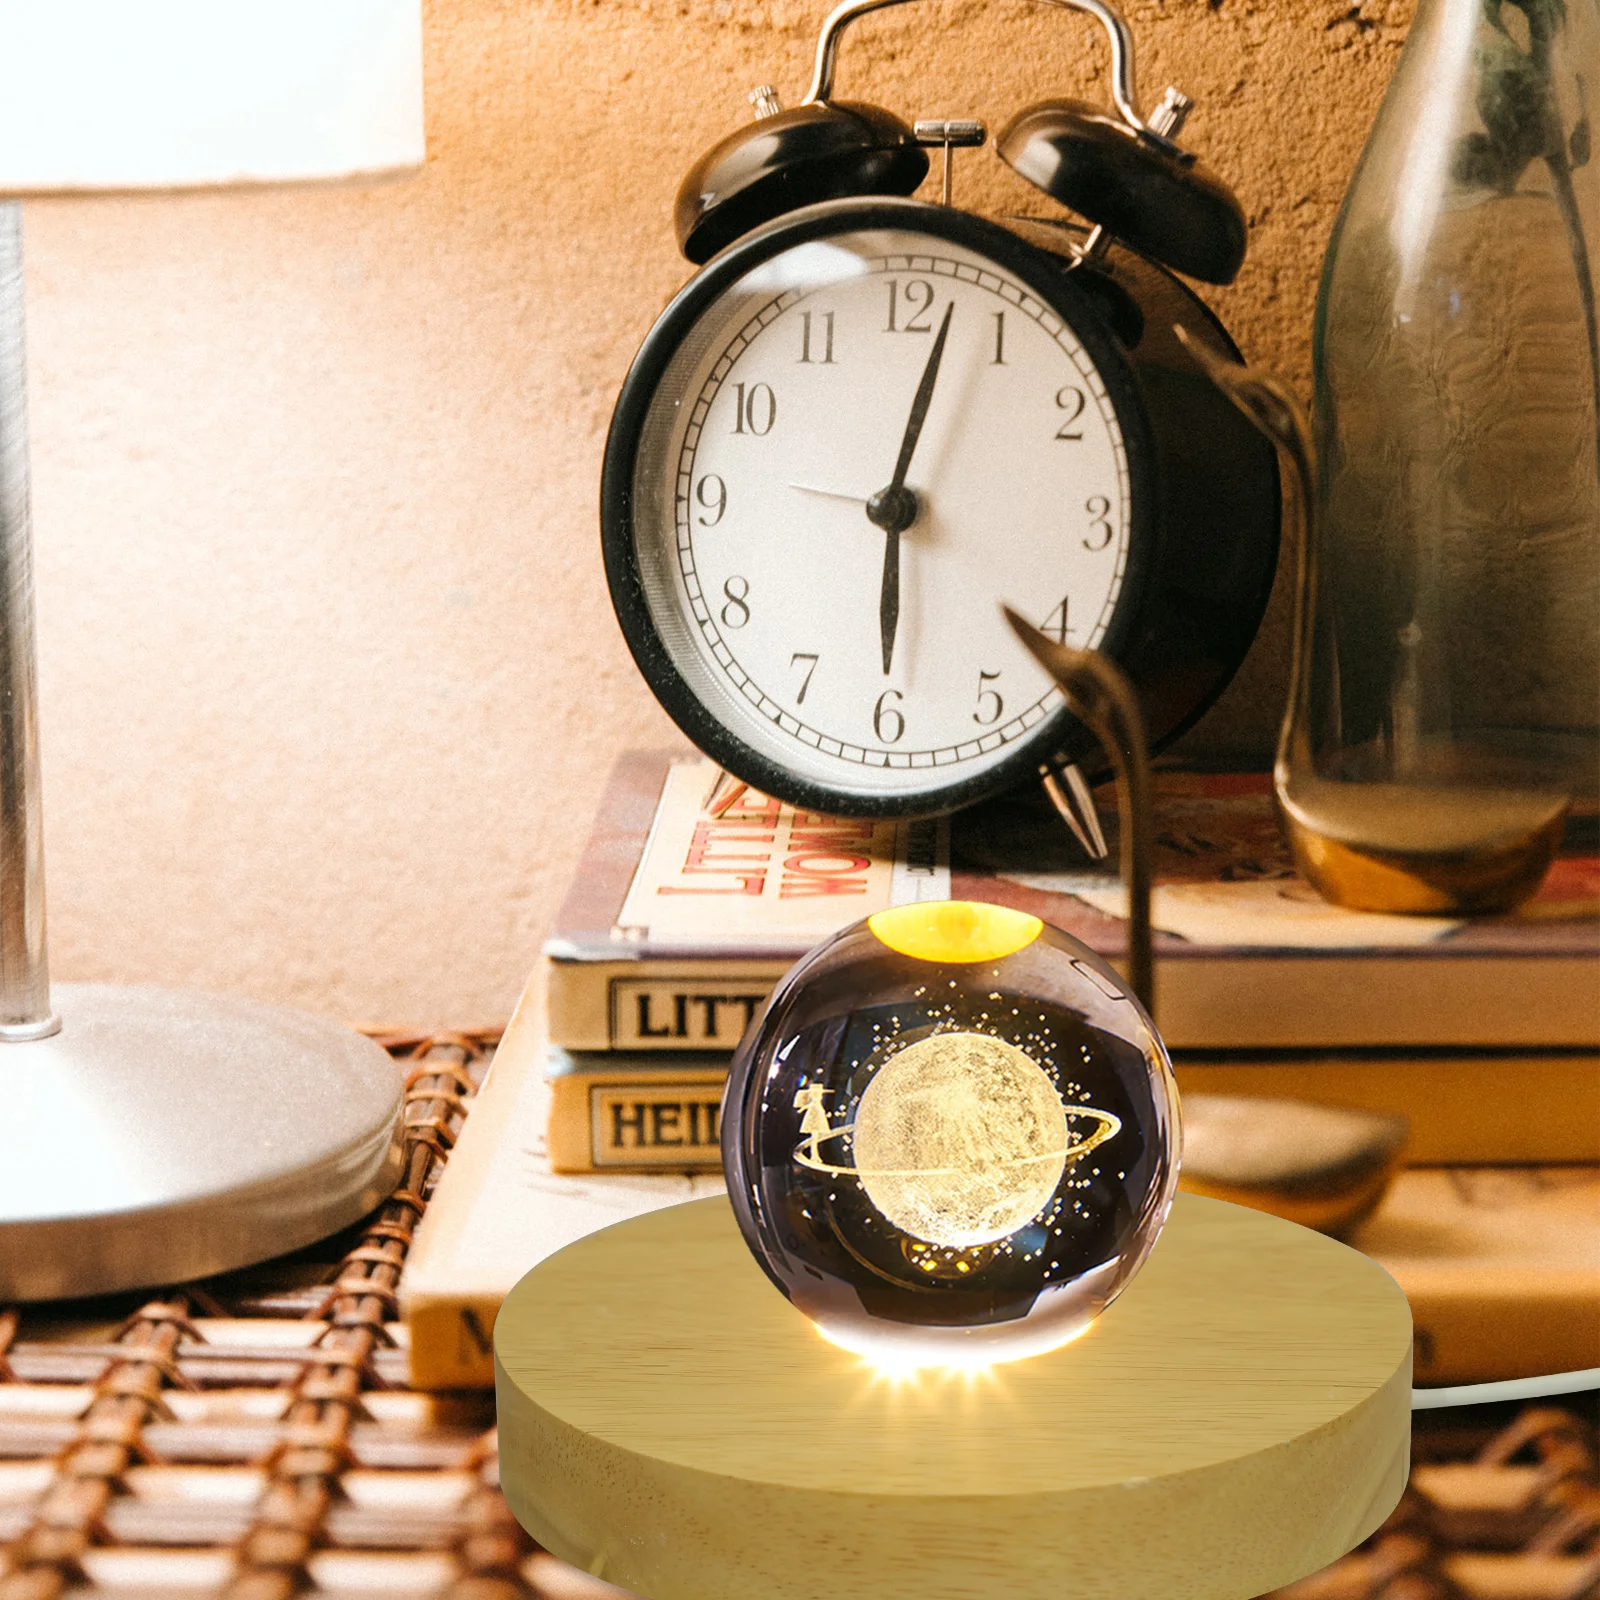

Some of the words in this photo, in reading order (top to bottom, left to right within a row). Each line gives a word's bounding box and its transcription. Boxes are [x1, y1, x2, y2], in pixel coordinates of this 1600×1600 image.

[882, 279, 934, 333] 12
[796, 311, 838, 364] 11
[989, 311, 1008, 365] 1
[730, 382, 777, 436] 10
[1054, 386, 1085, 441] 2
[696, 473, 727, 526] 9
[1083, 496, 1113, 552] 3
[720, 575, 751, 629] 8
[1040, 595, 1076, 645] 4
[790, 653, 820, 704] 7
[973, 670, 1003, 724] 5
[873, 689, 906, 744] 6
[780, 811, 874, 898] WOME
